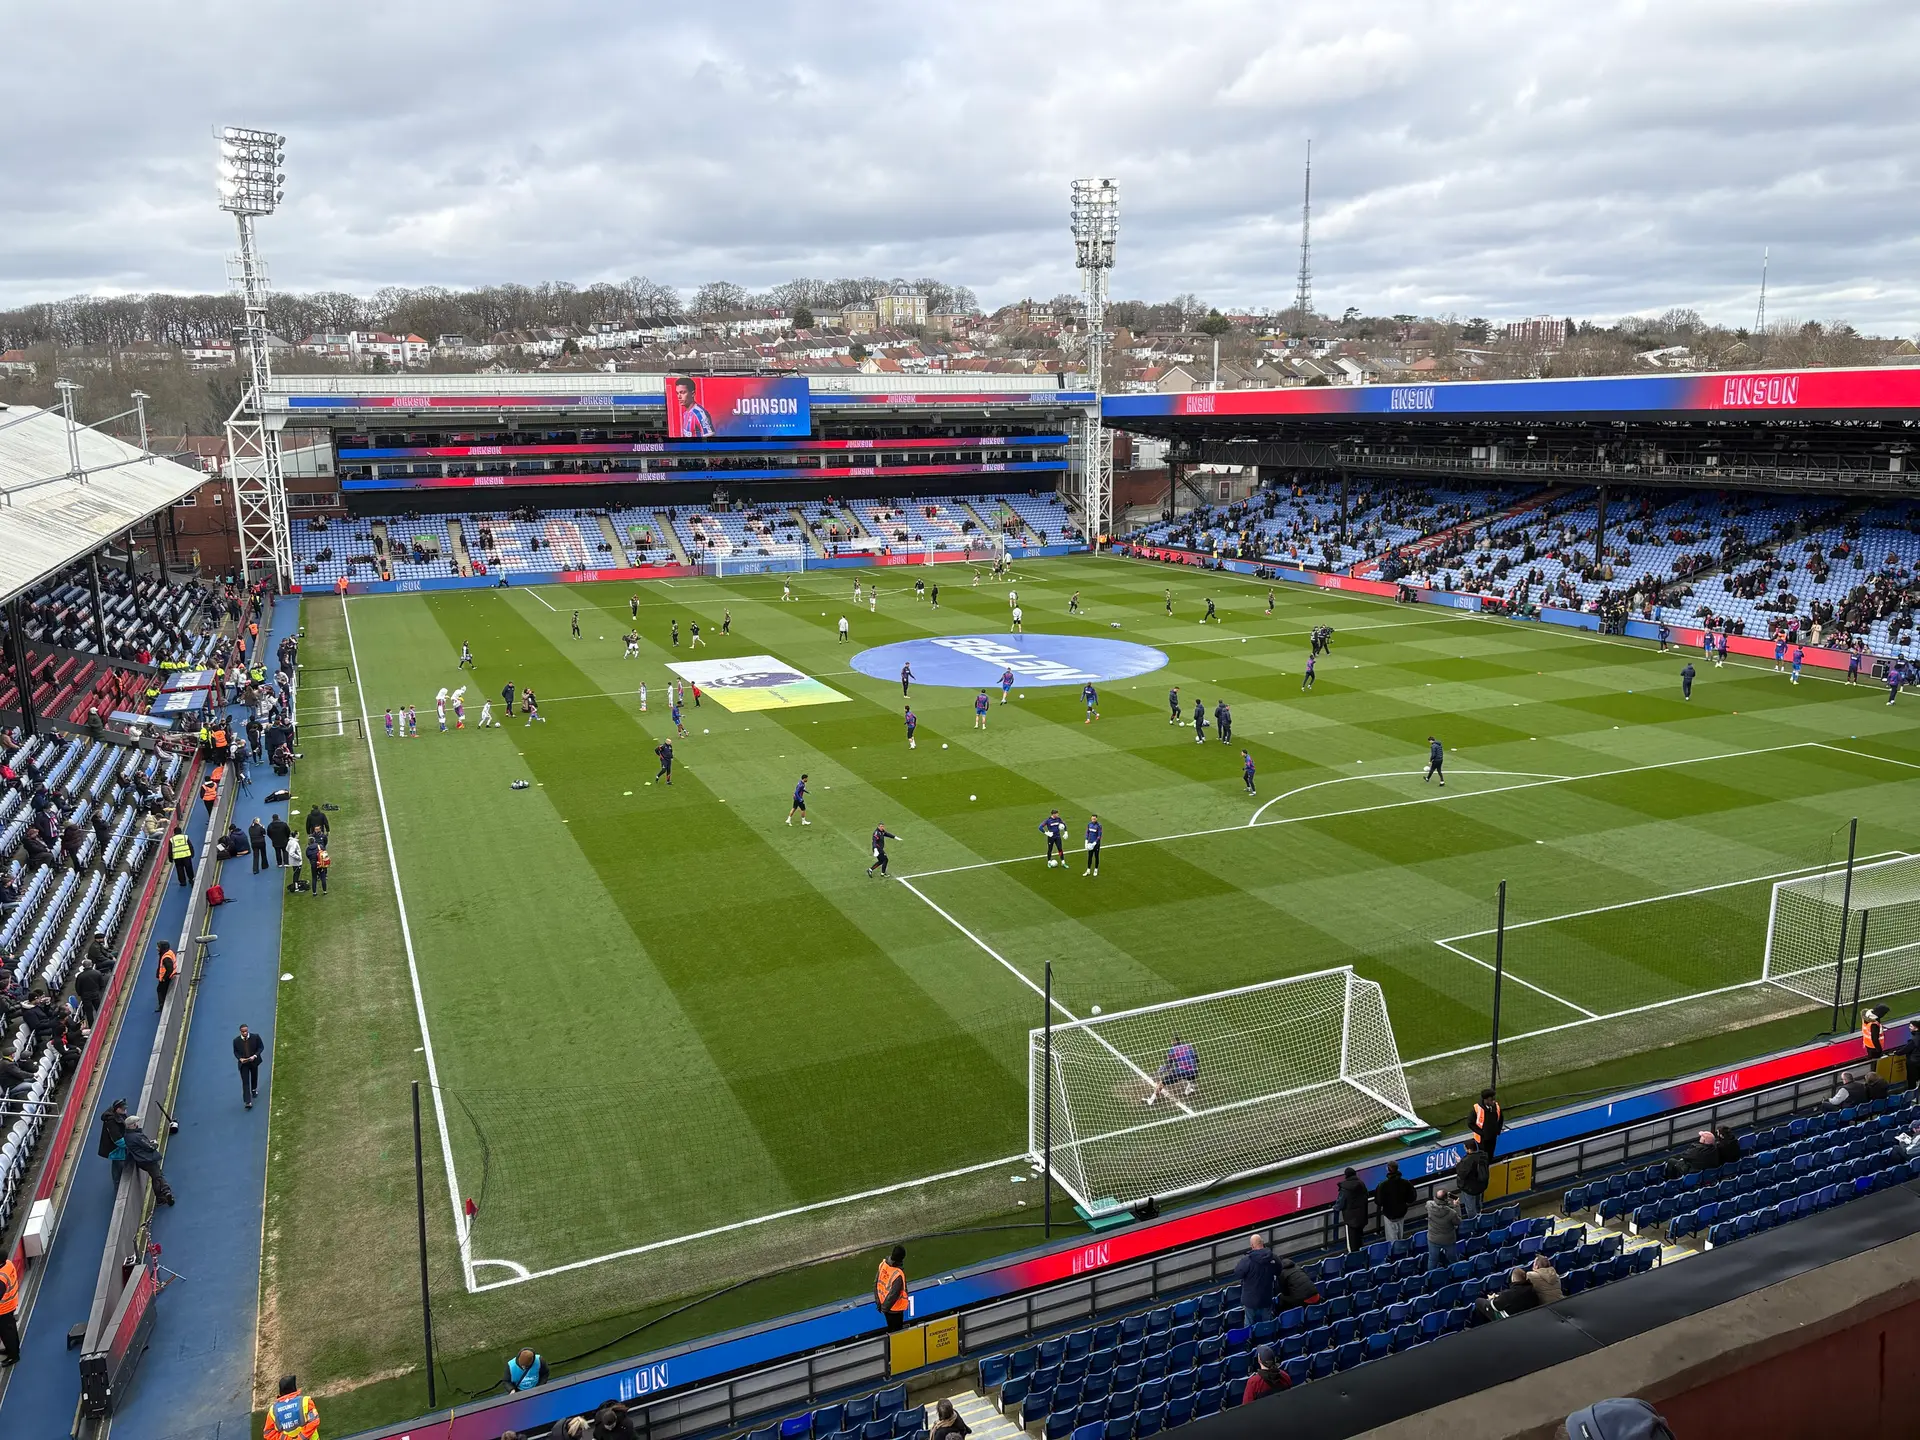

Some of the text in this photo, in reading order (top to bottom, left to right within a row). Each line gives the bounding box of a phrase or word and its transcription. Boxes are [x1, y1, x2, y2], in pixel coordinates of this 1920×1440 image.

[732, 398, 798, 415] JOHNSON
[1713, 1073, 1739, 1096] SON
[929, 1325, 957, 1337] EMERGENCY
